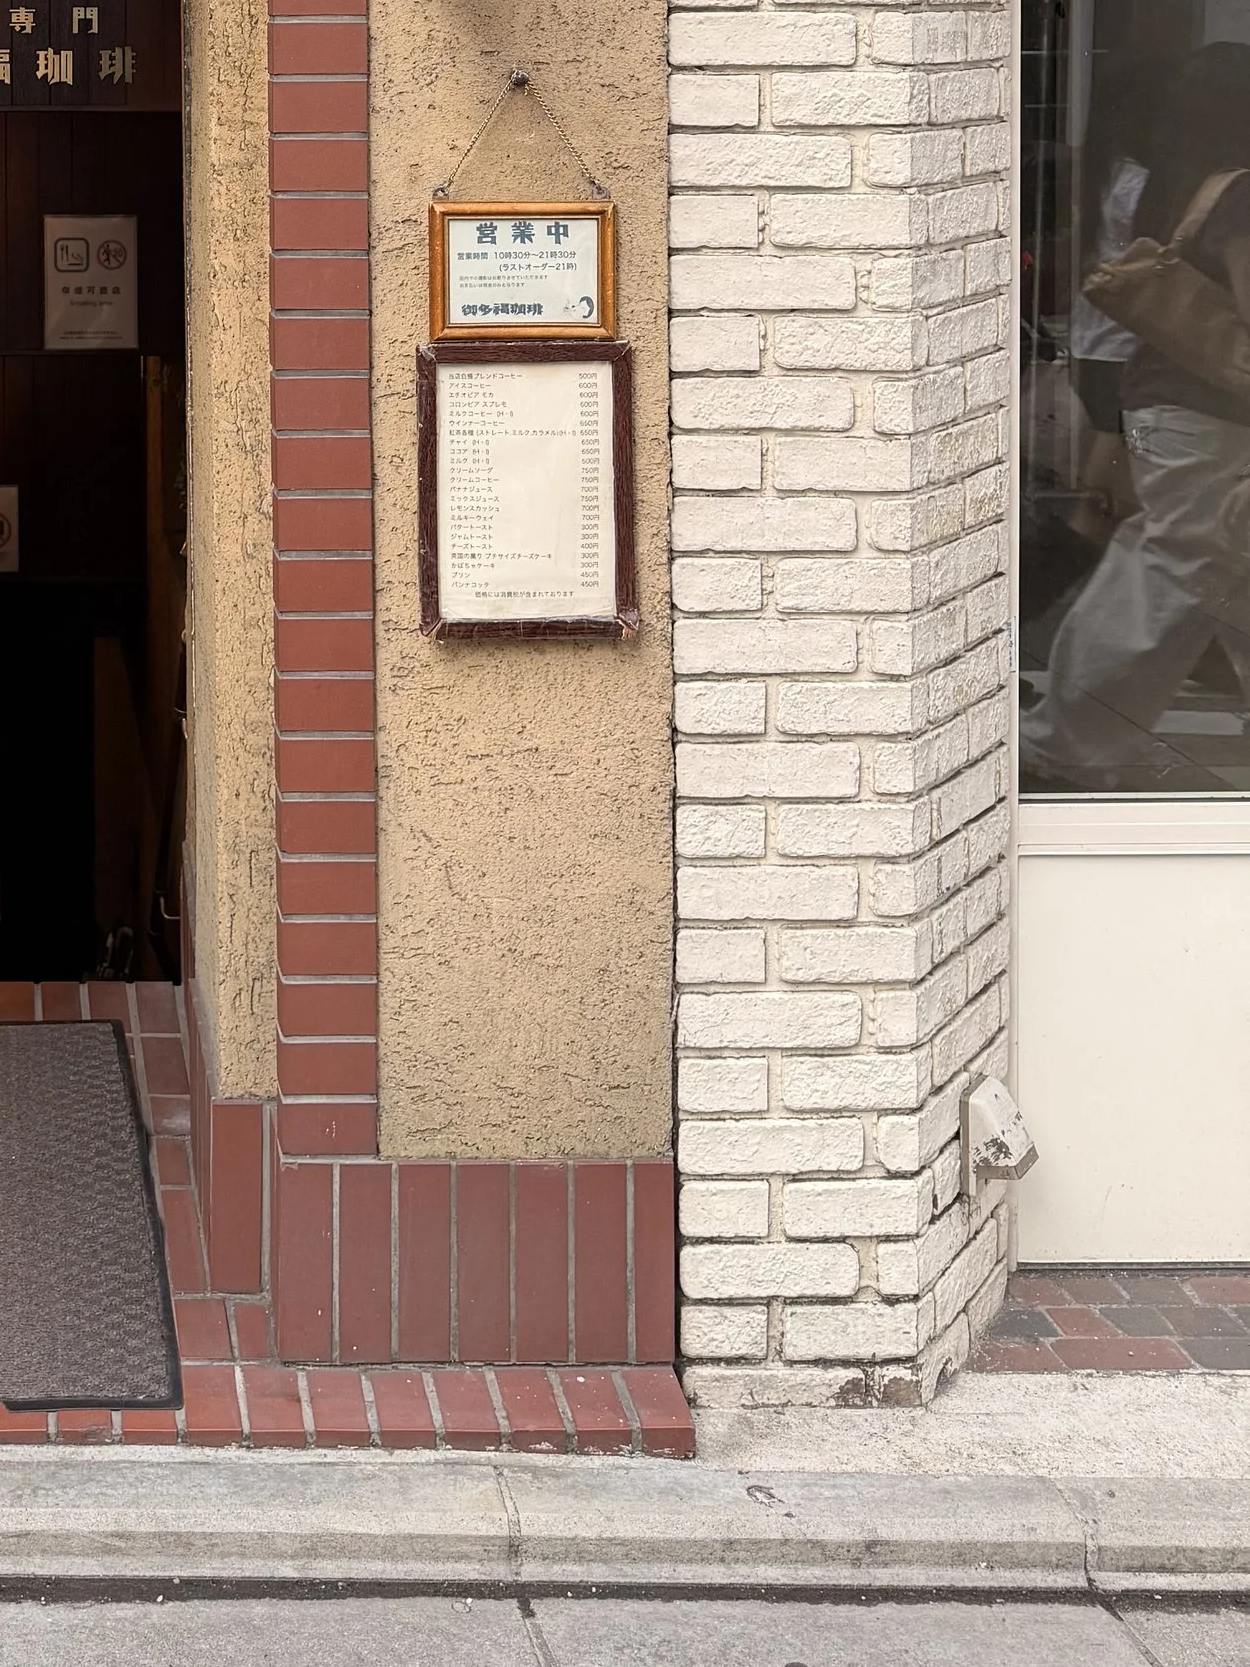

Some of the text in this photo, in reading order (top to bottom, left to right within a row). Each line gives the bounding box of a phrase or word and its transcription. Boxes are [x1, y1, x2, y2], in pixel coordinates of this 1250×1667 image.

[476, 220, 570, 245] 営業中
[457, 252, 489, 261] 営業時間
[461, 302, 544, 317] 御多福珈琲
[449, 382, 491, 390] アイスコーヒー
[483, 391, 494, 399] モカ
[449, 410, 493, 418] ミルクコーヒー
[449, 438, 467, 446] チャイ
[449, 447, 468, 455] ココア
[449, 457, 468, 465] ミルク
[449, 466, 493, 474] クリームソーダ
[449, 476, 500, 484] クリームコーヒー
[449, 485, 493, 493] バナナジュース
[450, 495, 500, 503] ミックスジュース
[450, 504, 500, 512] レモンスカッシュ
[450, 532, 494, 540] ジャムトースト
[450, 542, 494, 550] チーズトースト
[452, 570, 470, 578] プリン
